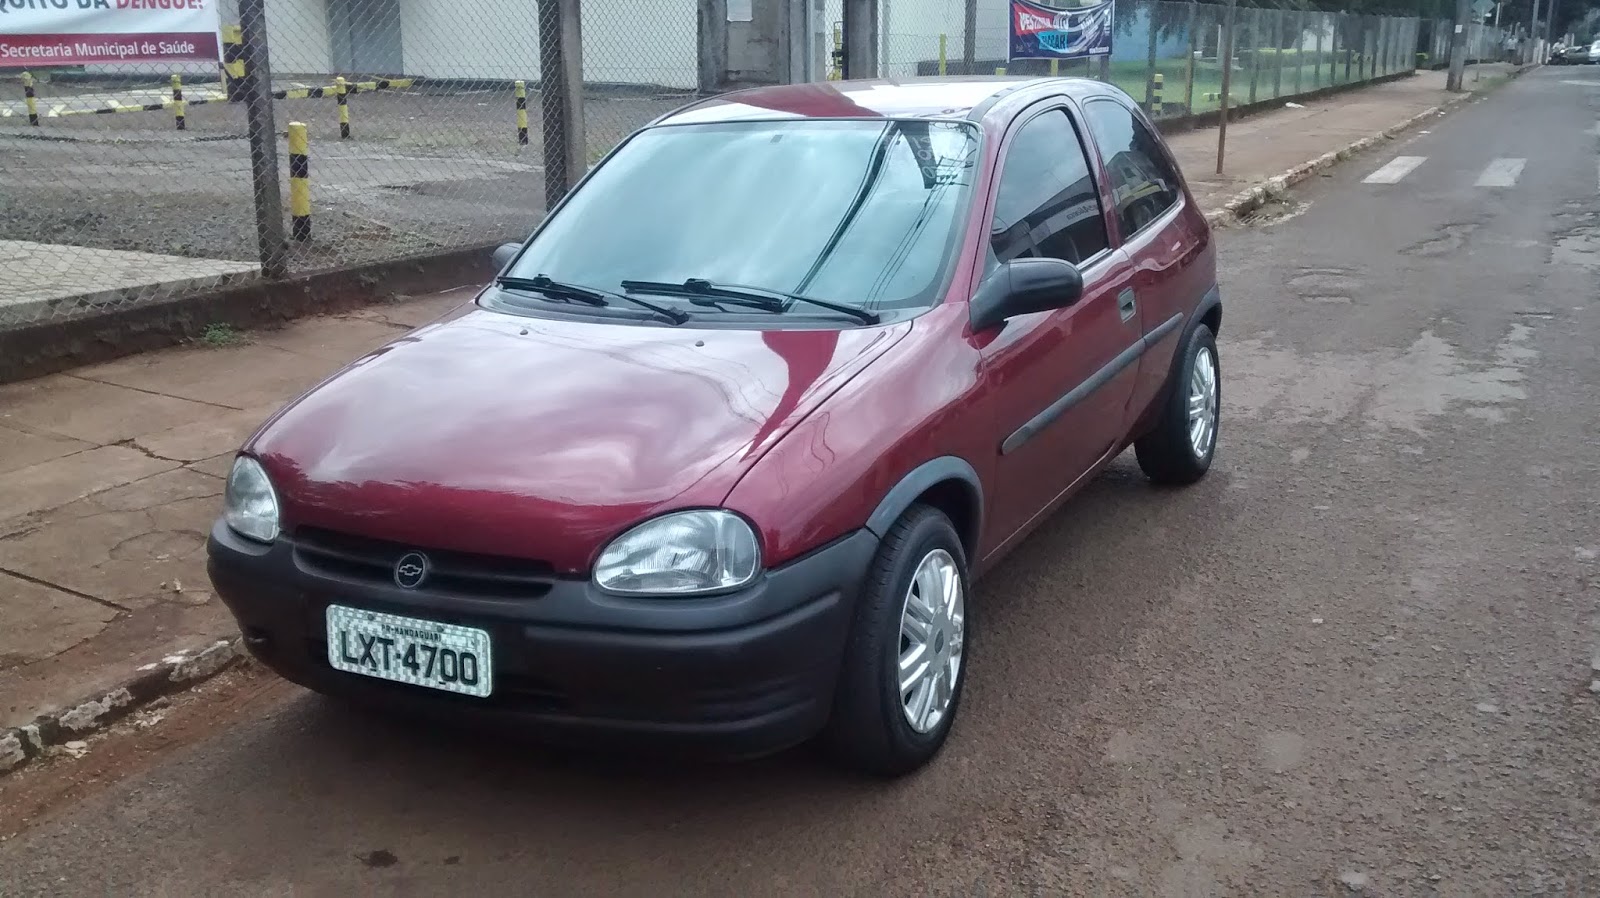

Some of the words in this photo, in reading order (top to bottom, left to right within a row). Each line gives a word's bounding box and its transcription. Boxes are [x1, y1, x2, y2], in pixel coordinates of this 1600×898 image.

[76, 0, 110, 9] DA
[116, 0, 204, 9] DENGUE!
[0, 43, 73, 58] Secretaria
[74, 41, 139, 59] Municipal
[141, 41, 157, 55] de
[158, 40, 195, 54] Saúde
[341, 630, 479, 686] LXT-4700
